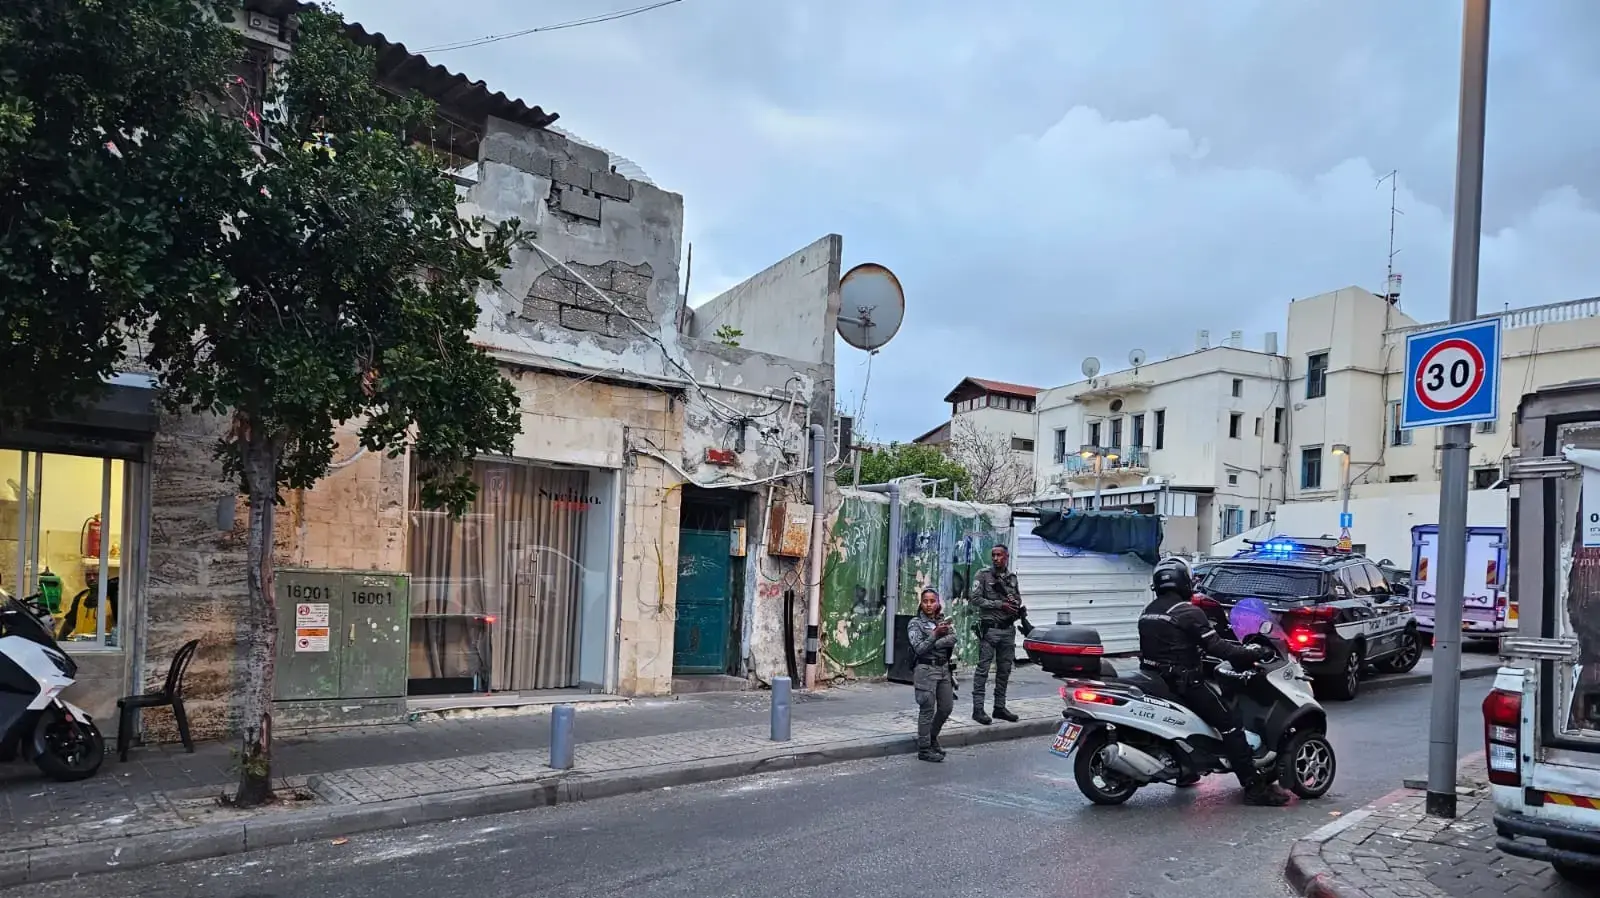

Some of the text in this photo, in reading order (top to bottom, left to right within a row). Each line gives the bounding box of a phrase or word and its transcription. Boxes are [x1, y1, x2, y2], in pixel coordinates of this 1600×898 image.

[1427, 359, 1469, 392] 30
[287, 585, 329, 600] 16001
[352, 592, 391, 604] 16001
